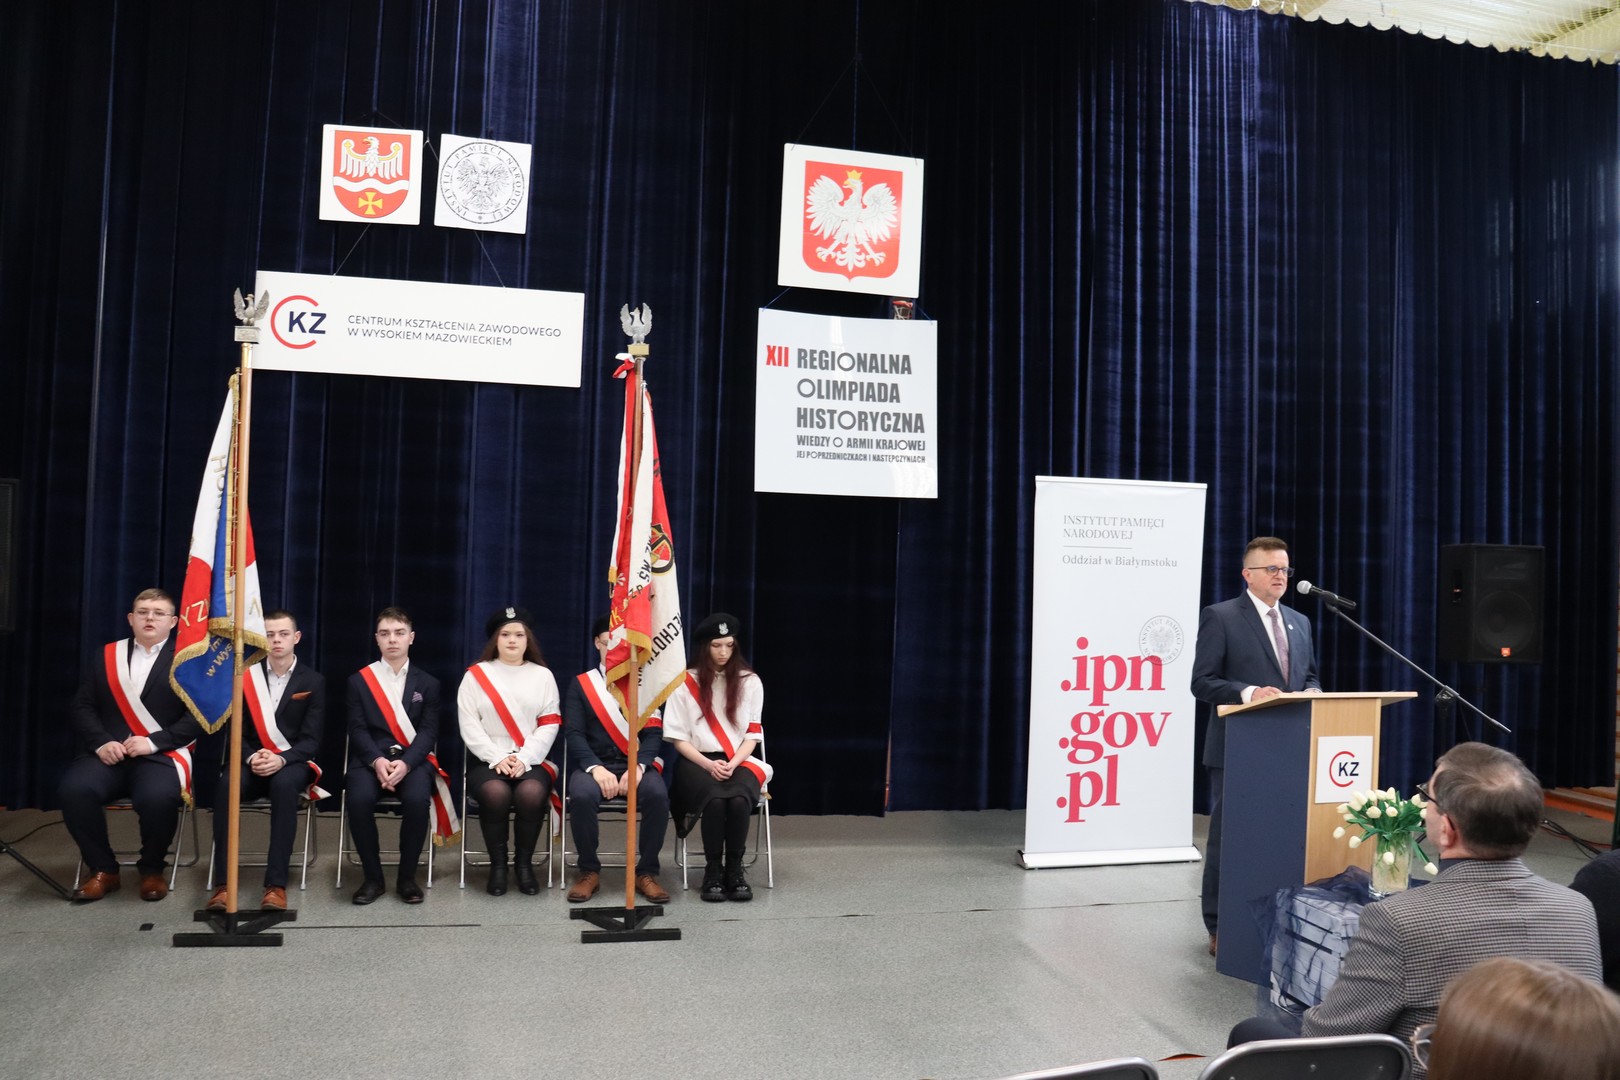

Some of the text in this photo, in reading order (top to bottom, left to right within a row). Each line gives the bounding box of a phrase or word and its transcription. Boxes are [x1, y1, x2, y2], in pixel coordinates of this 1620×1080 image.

[347, 314, 562, 338] CENTRUM KSZTAŁCENIA ZAWODOWEGO
[347, 327, 512, 346] W WYSOKIEM MAZOWIECKIEM
[766, 345, 912, 375] XII REGIONALNA
[797, 378, 901, 403] OLIMPIADA
[797, 407, 925, 433] HISTORYCZNA
[796, 435, 926, 451] WIEDZY O ARMII KRAJOWEJ
[796, 450, 805, 458] JEJ
[806, 451, 867, 461] POPRZEDNICZKACH
[872, 454, 926, 463] NASTĘPCZYNIACH
[1063, 515, 1165, 530] INSTYTUT PAMIĘCI
[1063, 528, 1133, 540] NARODOWEJ
[1062, 554, 1178, 568] Oddział w Białymstoku
[213, 642, 233, 666] Wys
[1060, 636, 1166, 706] .ipn
[1058, 709, 1172, 764] .gov
[1056, 754, 1121, 823] .pl
